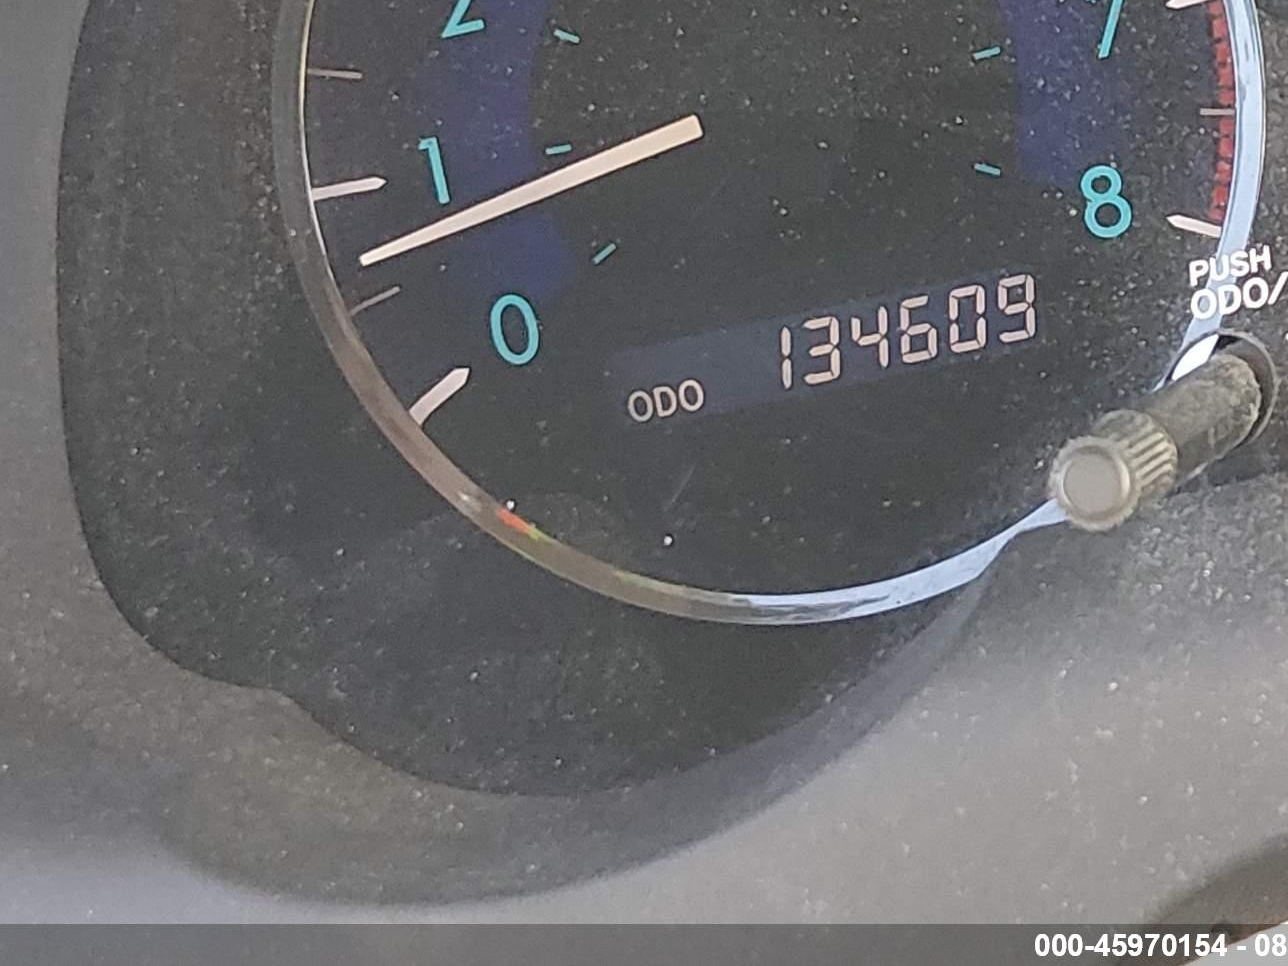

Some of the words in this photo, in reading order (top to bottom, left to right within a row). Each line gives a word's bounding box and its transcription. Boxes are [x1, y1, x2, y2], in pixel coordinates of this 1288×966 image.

[420, 138, 448, 202] 1
[1082, 167, 1131, 236] 8
[1188, 244, 1273, 287] PUSH
[491, 294, 538, 362] 0
[627, 378, 704, 423] ODO
[780, 273, 1036, 390] 134609
